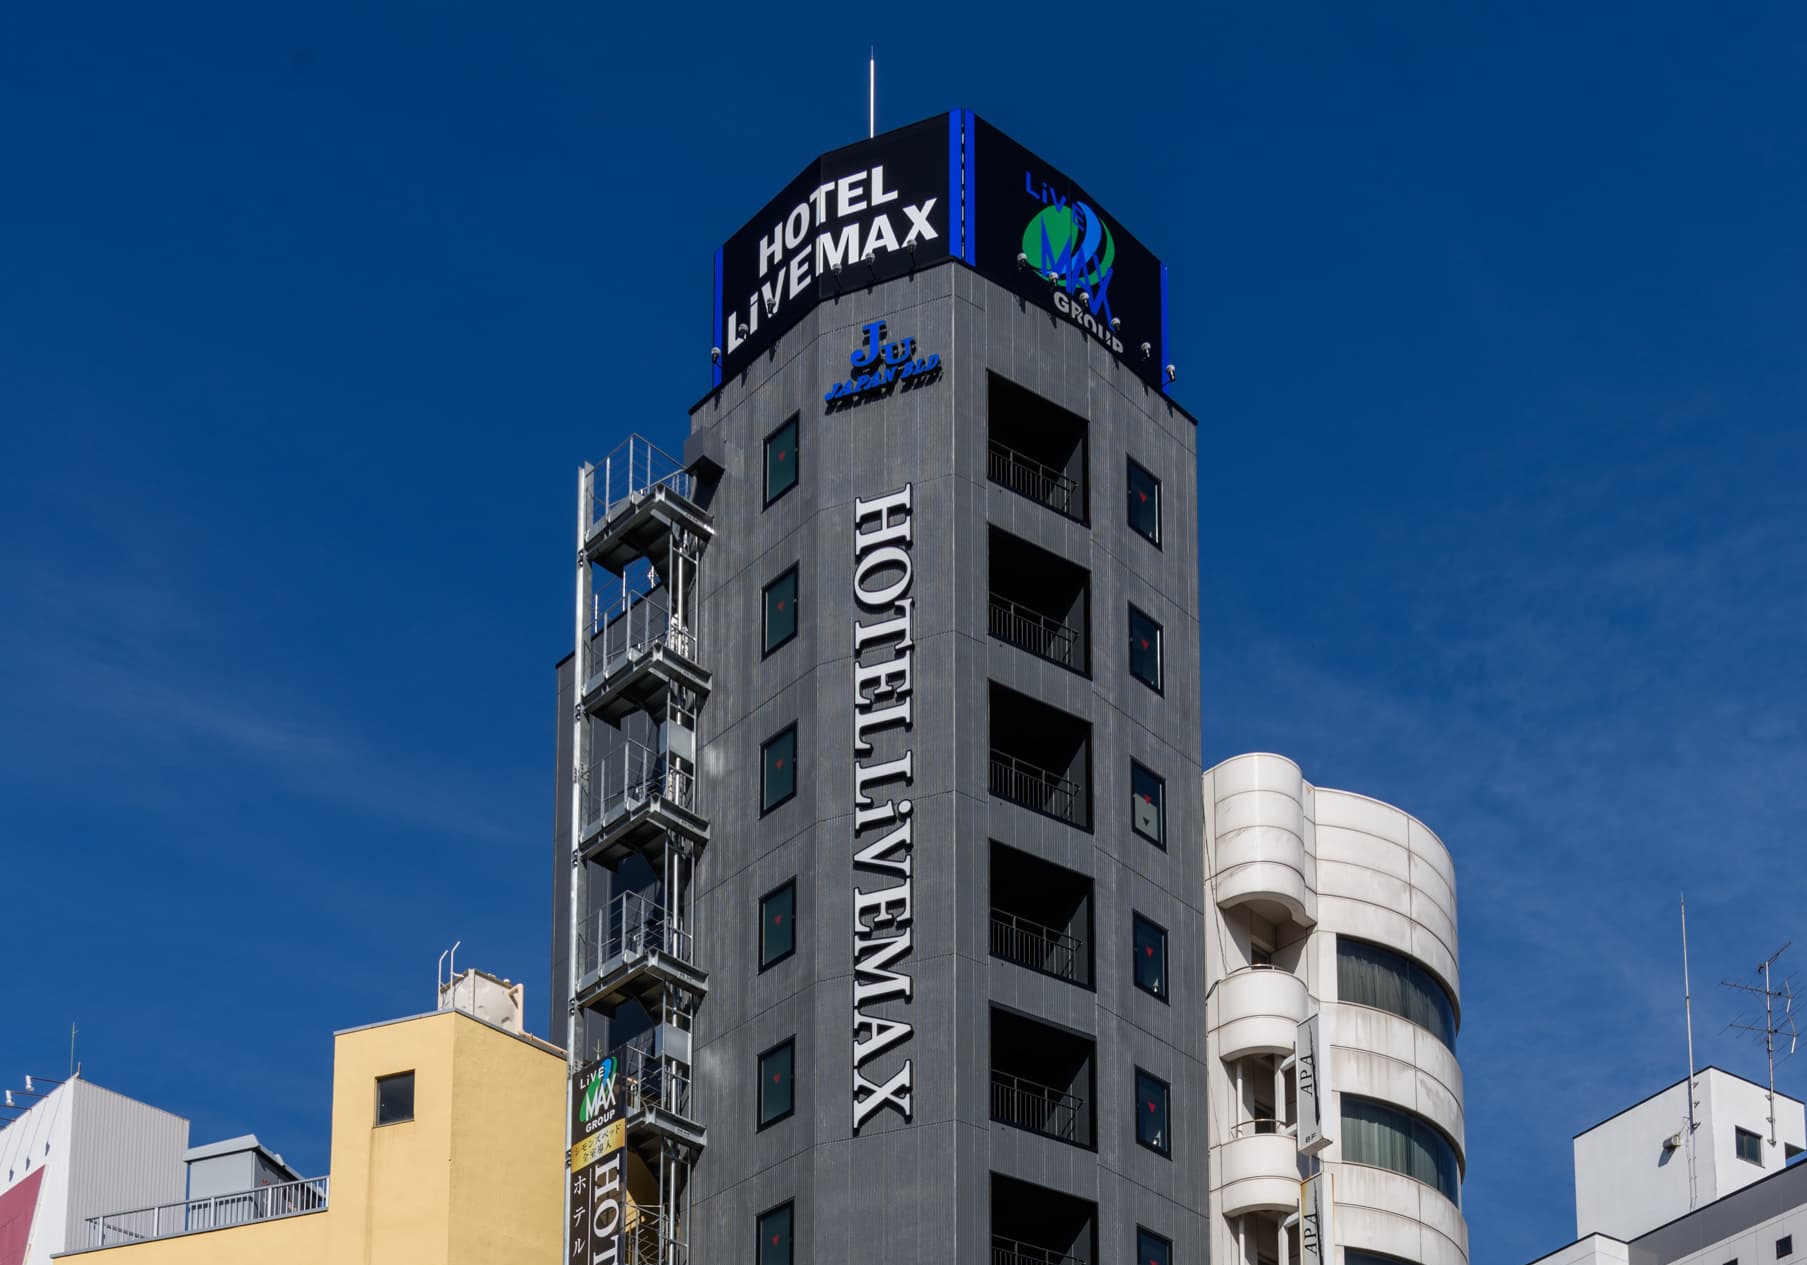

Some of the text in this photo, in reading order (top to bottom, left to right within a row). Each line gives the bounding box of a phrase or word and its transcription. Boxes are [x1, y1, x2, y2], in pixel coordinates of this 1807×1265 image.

[759, 165, 898, 278] HOTEL
[1040, 213, 1115, 332] MAX
[1053, 290, 1124, 354] GROUP
[824, 353, 941, 401] JAPAN BLD
[853, 482, 914, 750] HOTEL
[585, 1073, 617, 1122] MAX
[1300, 1054, 1313, 1097] APA
[585, 1109, 616, 1133] GROUP
[1303, 1211, 1318, 1258] APA
